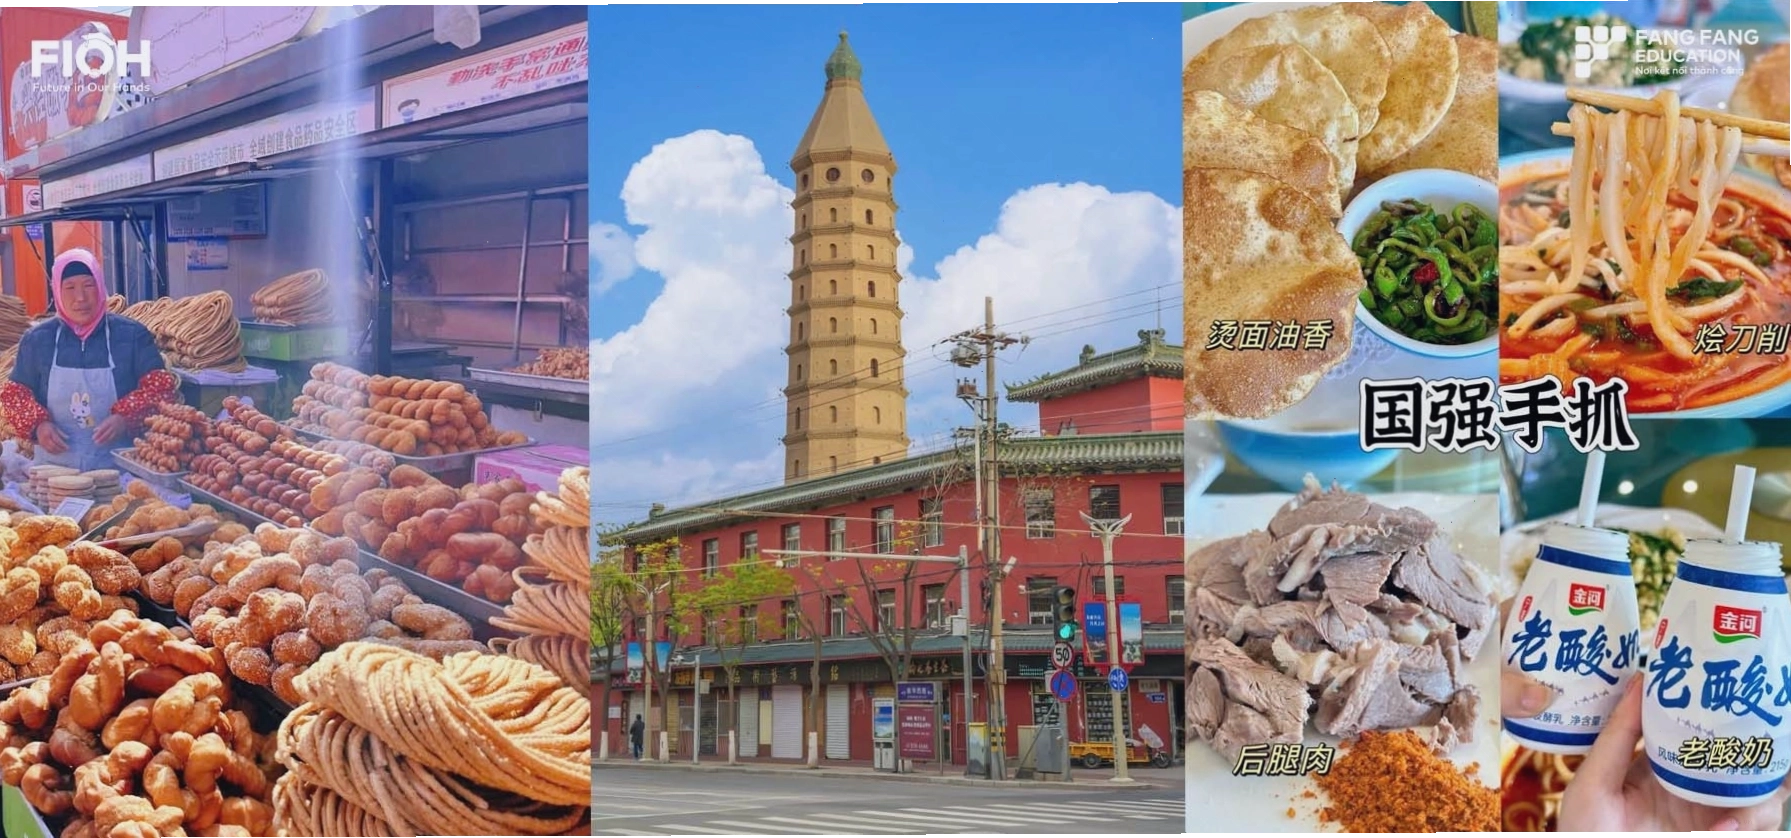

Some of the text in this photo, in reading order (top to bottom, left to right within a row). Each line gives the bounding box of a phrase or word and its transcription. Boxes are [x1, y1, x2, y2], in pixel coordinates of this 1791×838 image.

[448, 36, 588, 87] 勤洗手常通
[1055, 647, 1070, 662] 50
